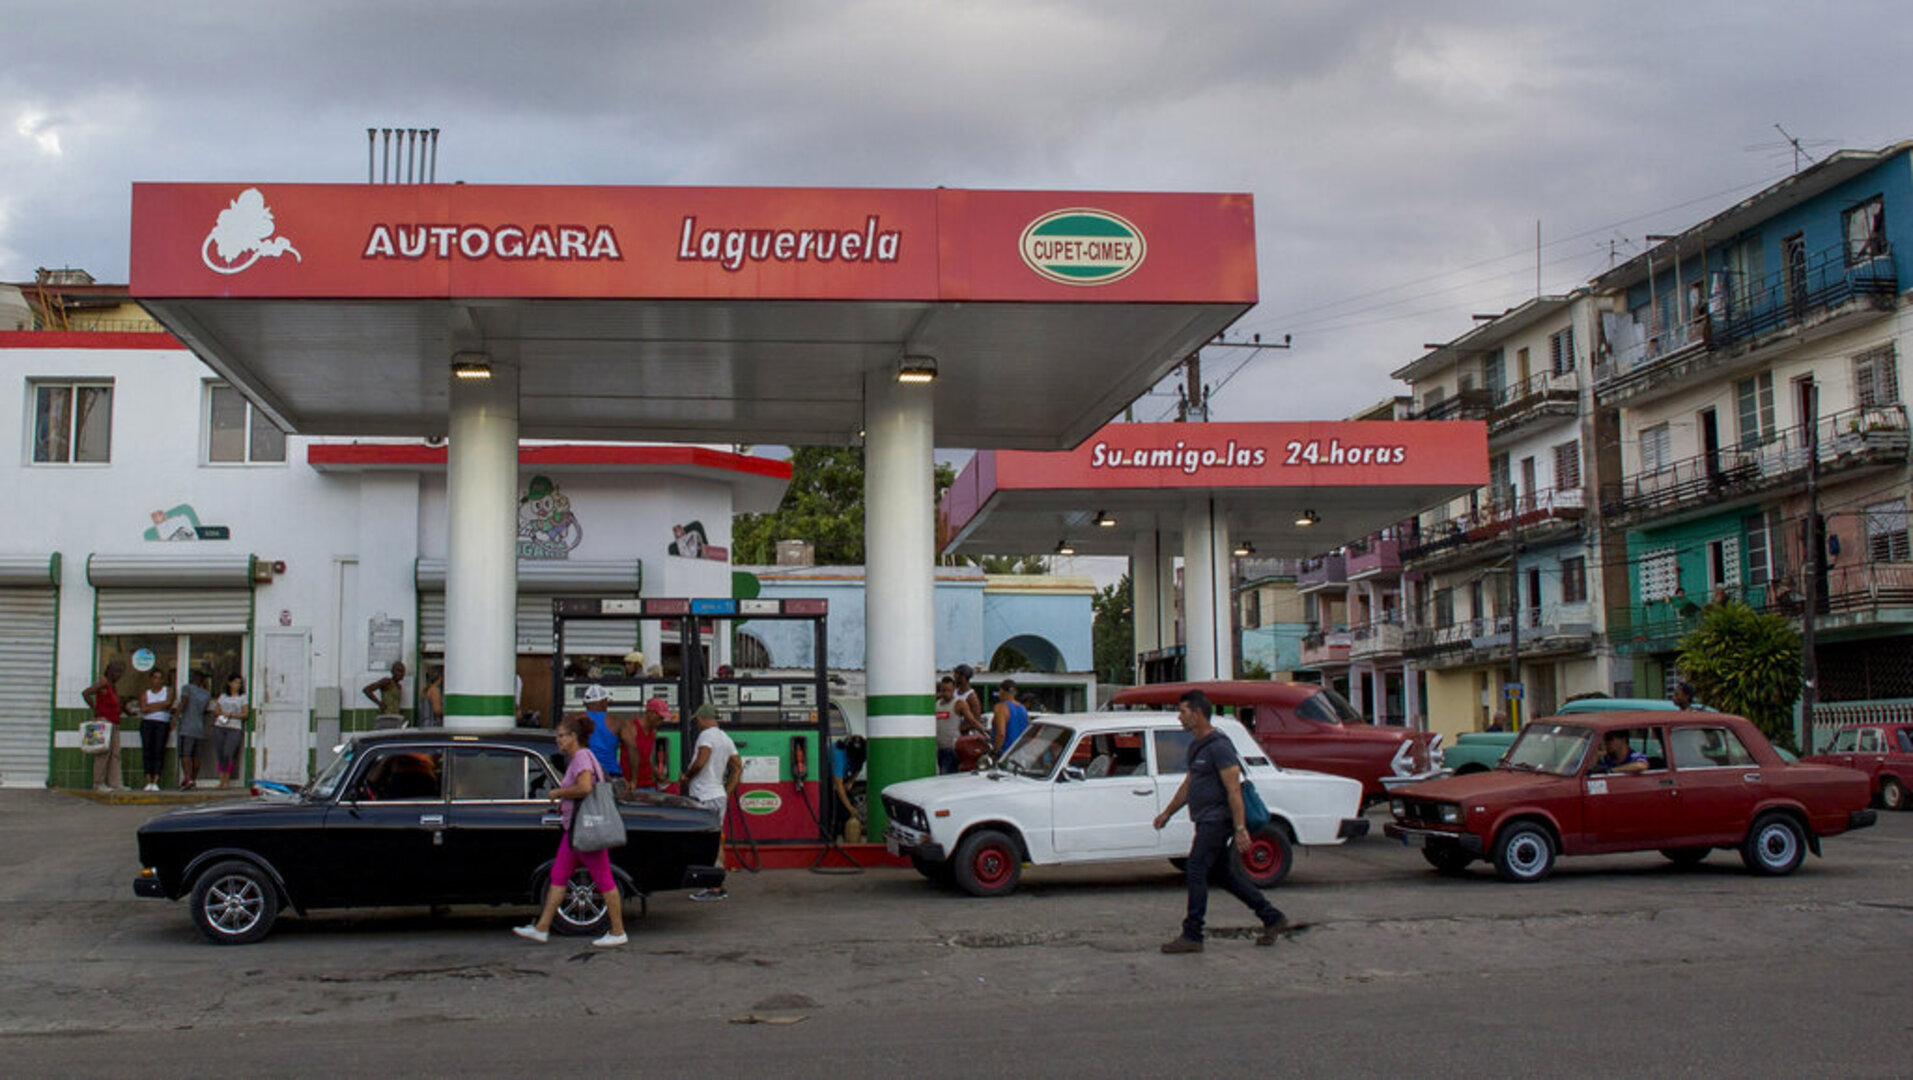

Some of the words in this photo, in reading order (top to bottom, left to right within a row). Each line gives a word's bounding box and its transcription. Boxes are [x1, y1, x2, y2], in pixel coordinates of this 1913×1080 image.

[363, 224, 622, 260] AUTOGARA
[678, 216, 900, 271] Lagueruela
[1033, 240, 1134, 261] CUPET-CIMEX
[1091, 442, 1123, 467] Su
[1132, 440, 1217, 474] amigo
[1226, 440, 1267, 467] las
[1284, 440, 1320, 465] 24
[1328, 439, 1406, 465] horas
